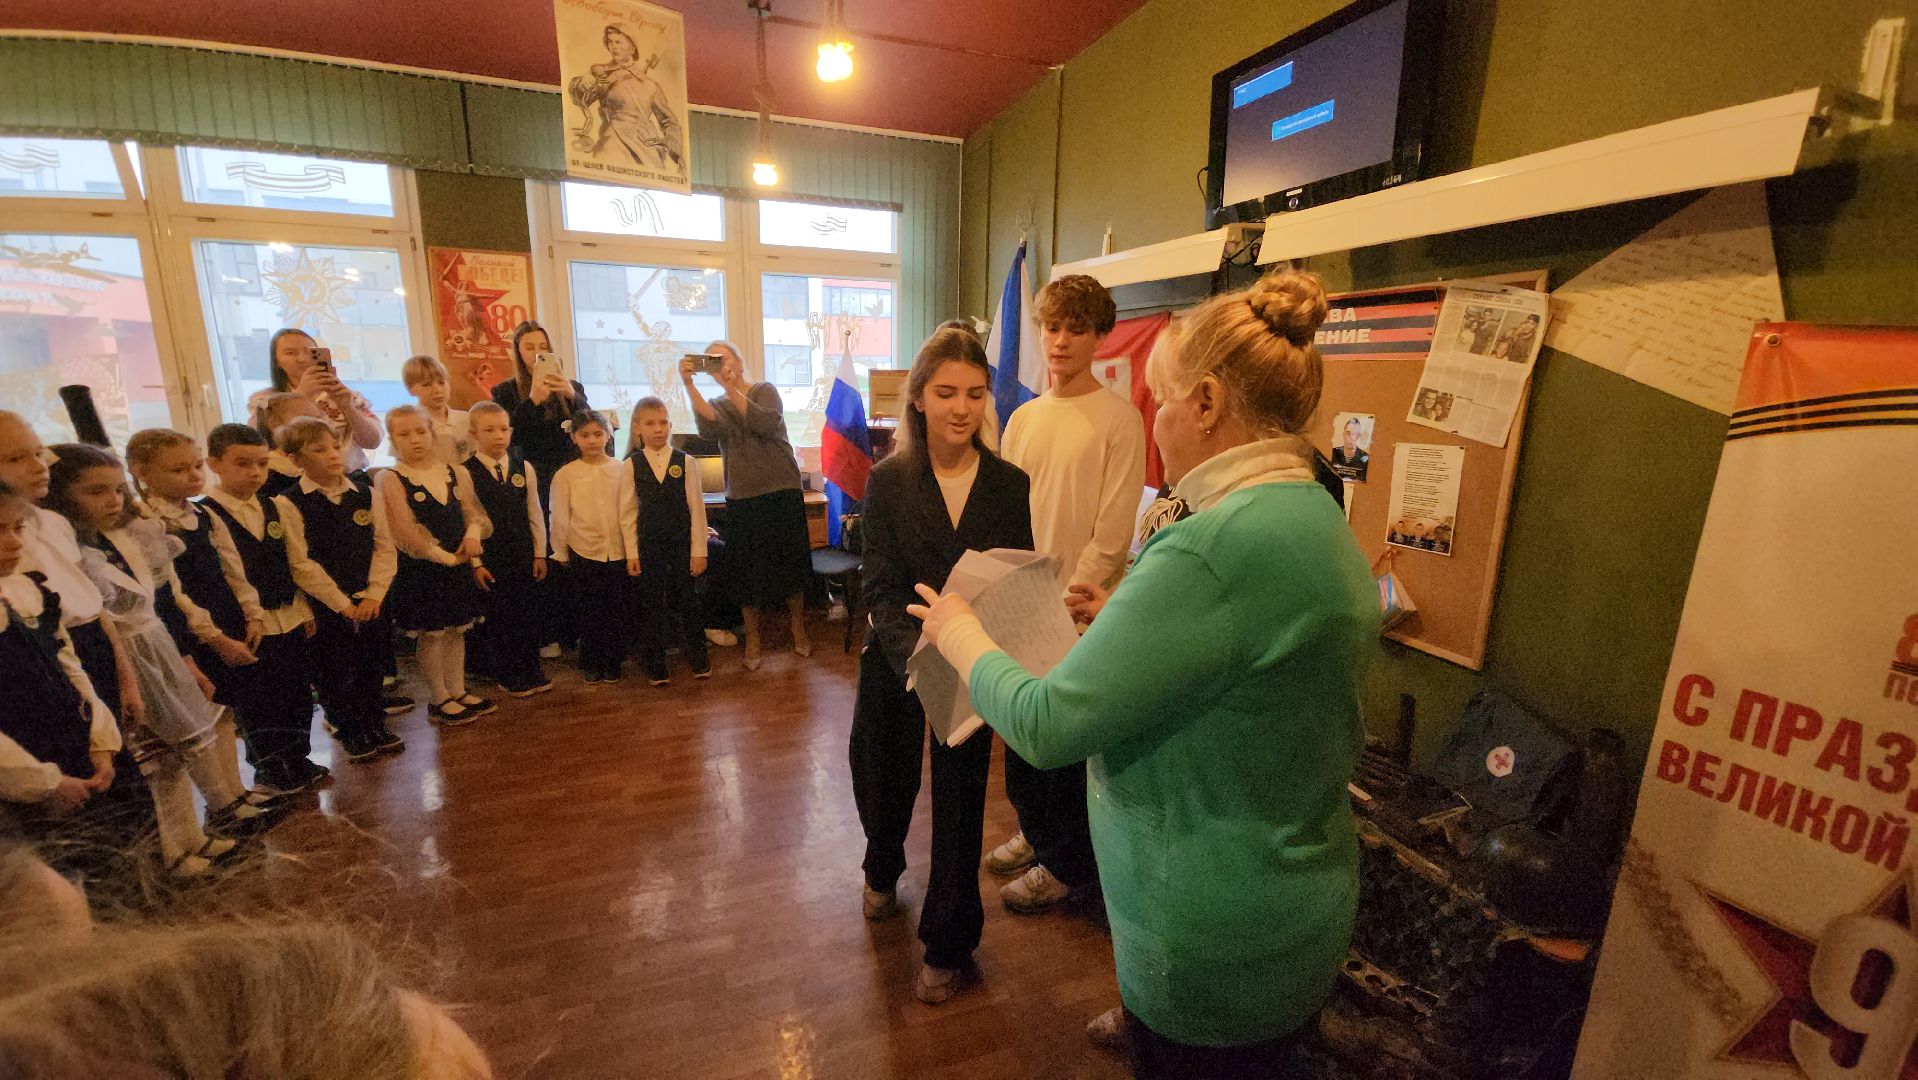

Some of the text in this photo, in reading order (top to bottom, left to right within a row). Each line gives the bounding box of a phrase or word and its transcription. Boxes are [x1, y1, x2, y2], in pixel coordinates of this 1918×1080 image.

[491, 304, 527, 334] 80
[1323, 307, 1357, 324] ВА
[1313, 327, 1371, 345] ЕНИЕ
[1883, 671, 1918, 707] ПО
[1672, 673, 1918, 814] С ПРАЗ
[1656, 739, 1912, 873] ВЕЛИКОЙ
